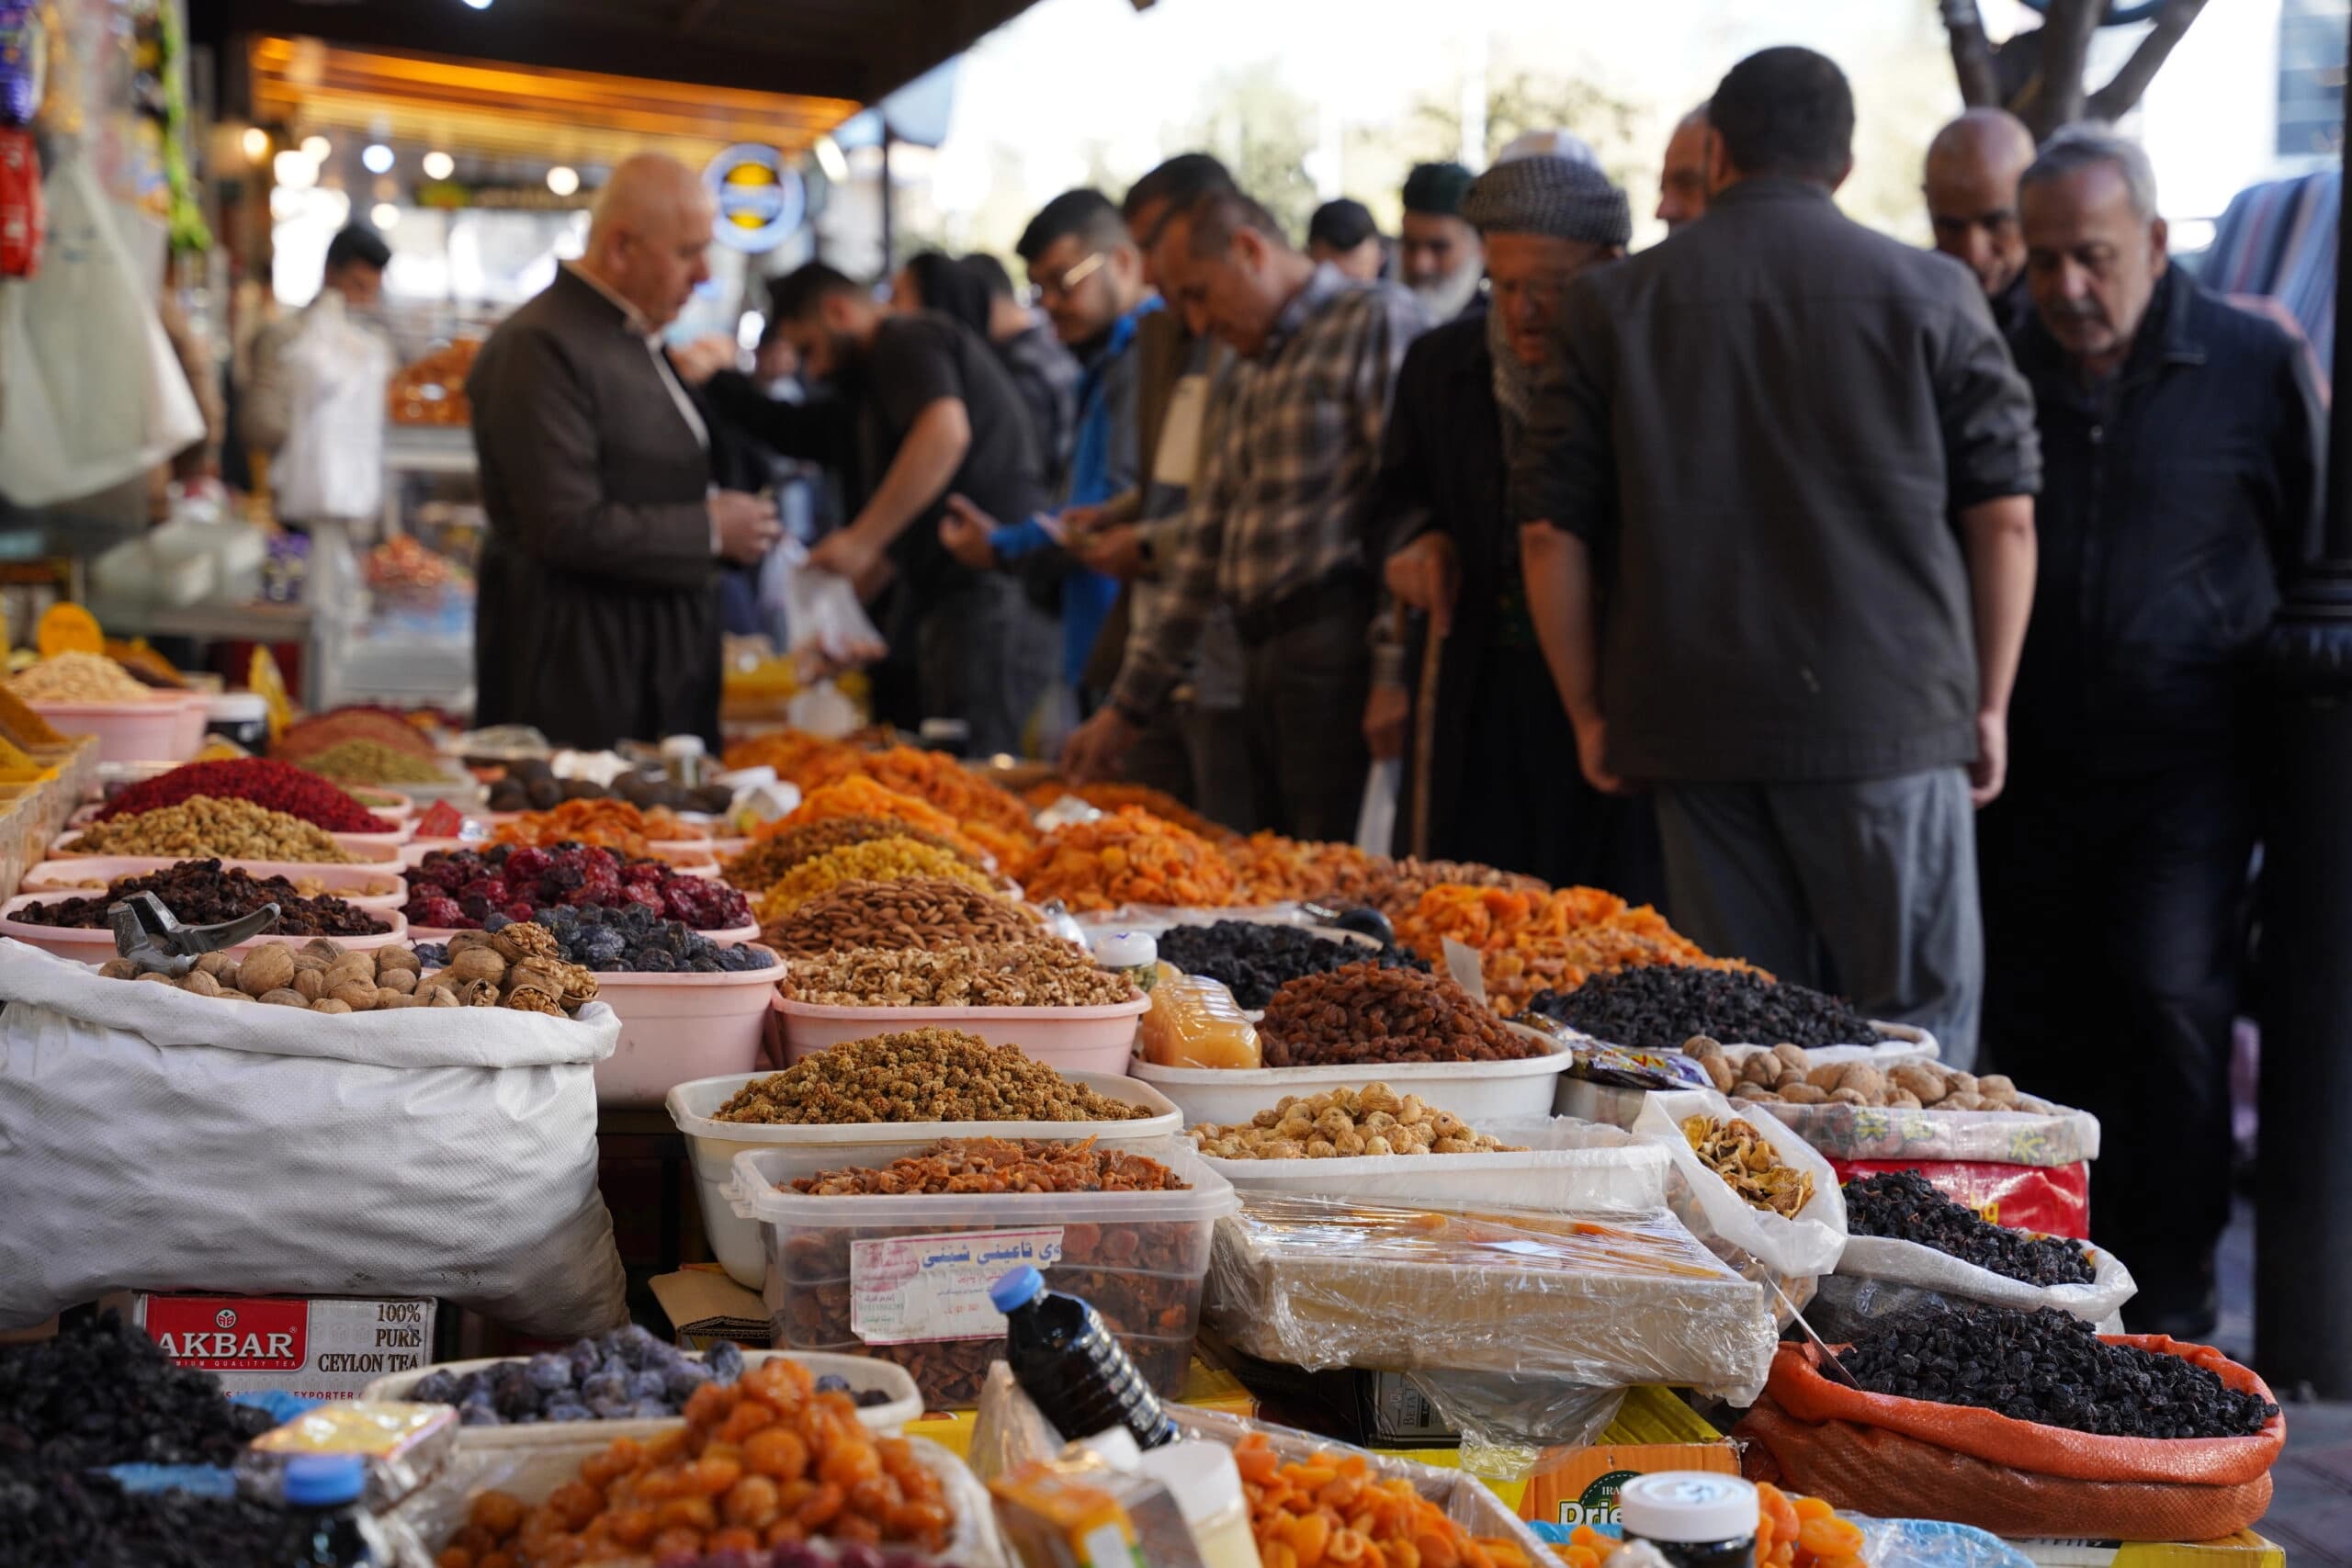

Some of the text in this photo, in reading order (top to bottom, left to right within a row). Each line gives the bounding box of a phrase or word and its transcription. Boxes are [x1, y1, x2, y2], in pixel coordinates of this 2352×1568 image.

[377, 1303, 421, 1323] 100%
[159, 1332, 295, 1358] AKBAR
[375, 1328, 420, 1348] PURE
[318, 1353, 418, 1373] CEYLON TEA
[293, 1391, 354, 1401] EXPORTER
[1601, 1485, 1621, 1495] IRA
[1559, 1500, 1623, 1525] Drie
